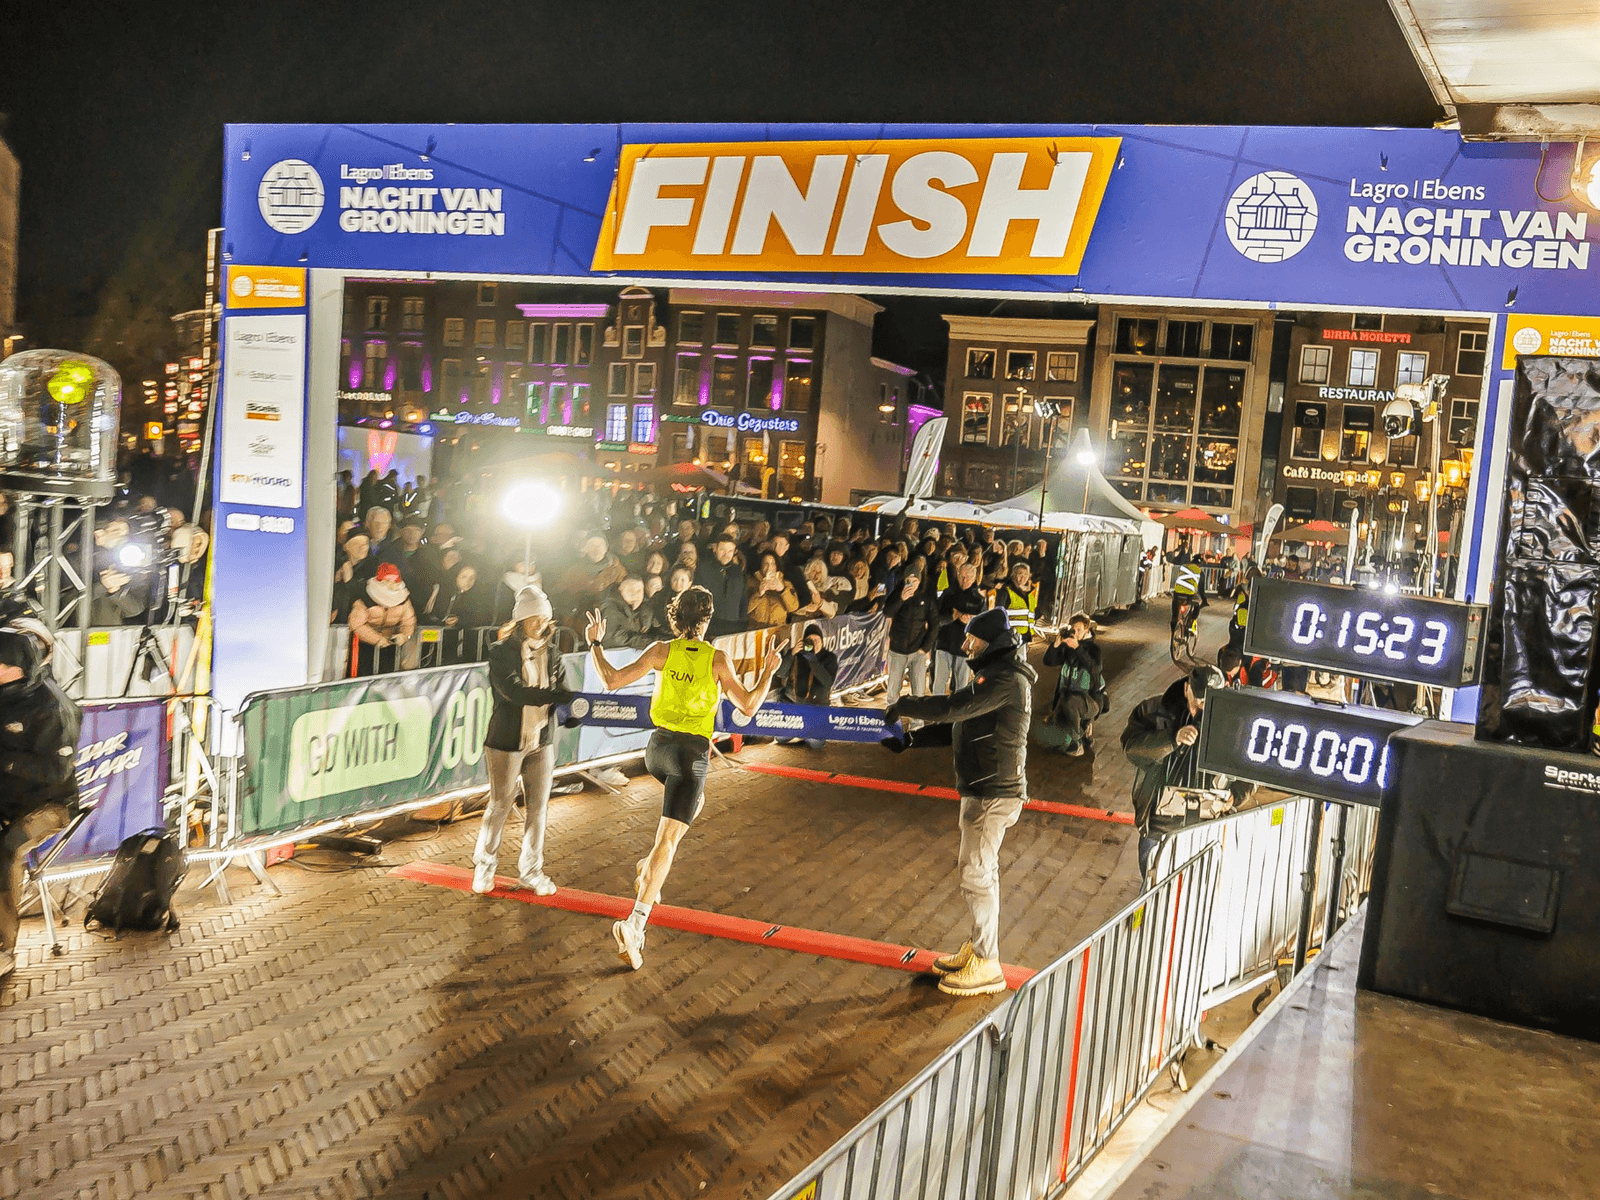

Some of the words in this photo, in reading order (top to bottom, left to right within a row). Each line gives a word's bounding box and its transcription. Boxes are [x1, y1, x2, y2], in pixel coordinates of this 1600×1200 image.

[340, 163, 382, 184] Lagro
[389, 163, 434, 181] Ebens
[339, 186, 438, 210] NACHT
[440, 188, 503, 211] VAN
[1349, 178, 1409, 204] Lagro
[1421, 179, 1486, 201] Ebens
[613, 151, 1093, 259] FINISH
[338, 209, 506, 236] GRONINGEN
[1346, 205, 1490, 236] NACHT
[1498, 209, 1588, 240] VAN
[1343, 235, 1591, 270] GRONINGEN
[1323, 328, 1358, 341] BIRRA
[1360, 331, 1412, 344] MORETTI
[1549, 337, 1593, 348] NACHT
[1319, 386, 1395, 402] RESTAURAN
[701, 410, 735, 427] Drie
[737, 412, 799, 433] Gezusters
[1282, 465, 1309, 479] Café
[1291, 602, 1449, 666] 0:15:23
[669, 669, 694, 684] RUN
[828, 714, 855, 727] Lagro
[344, 722, 399, 770] WITH
